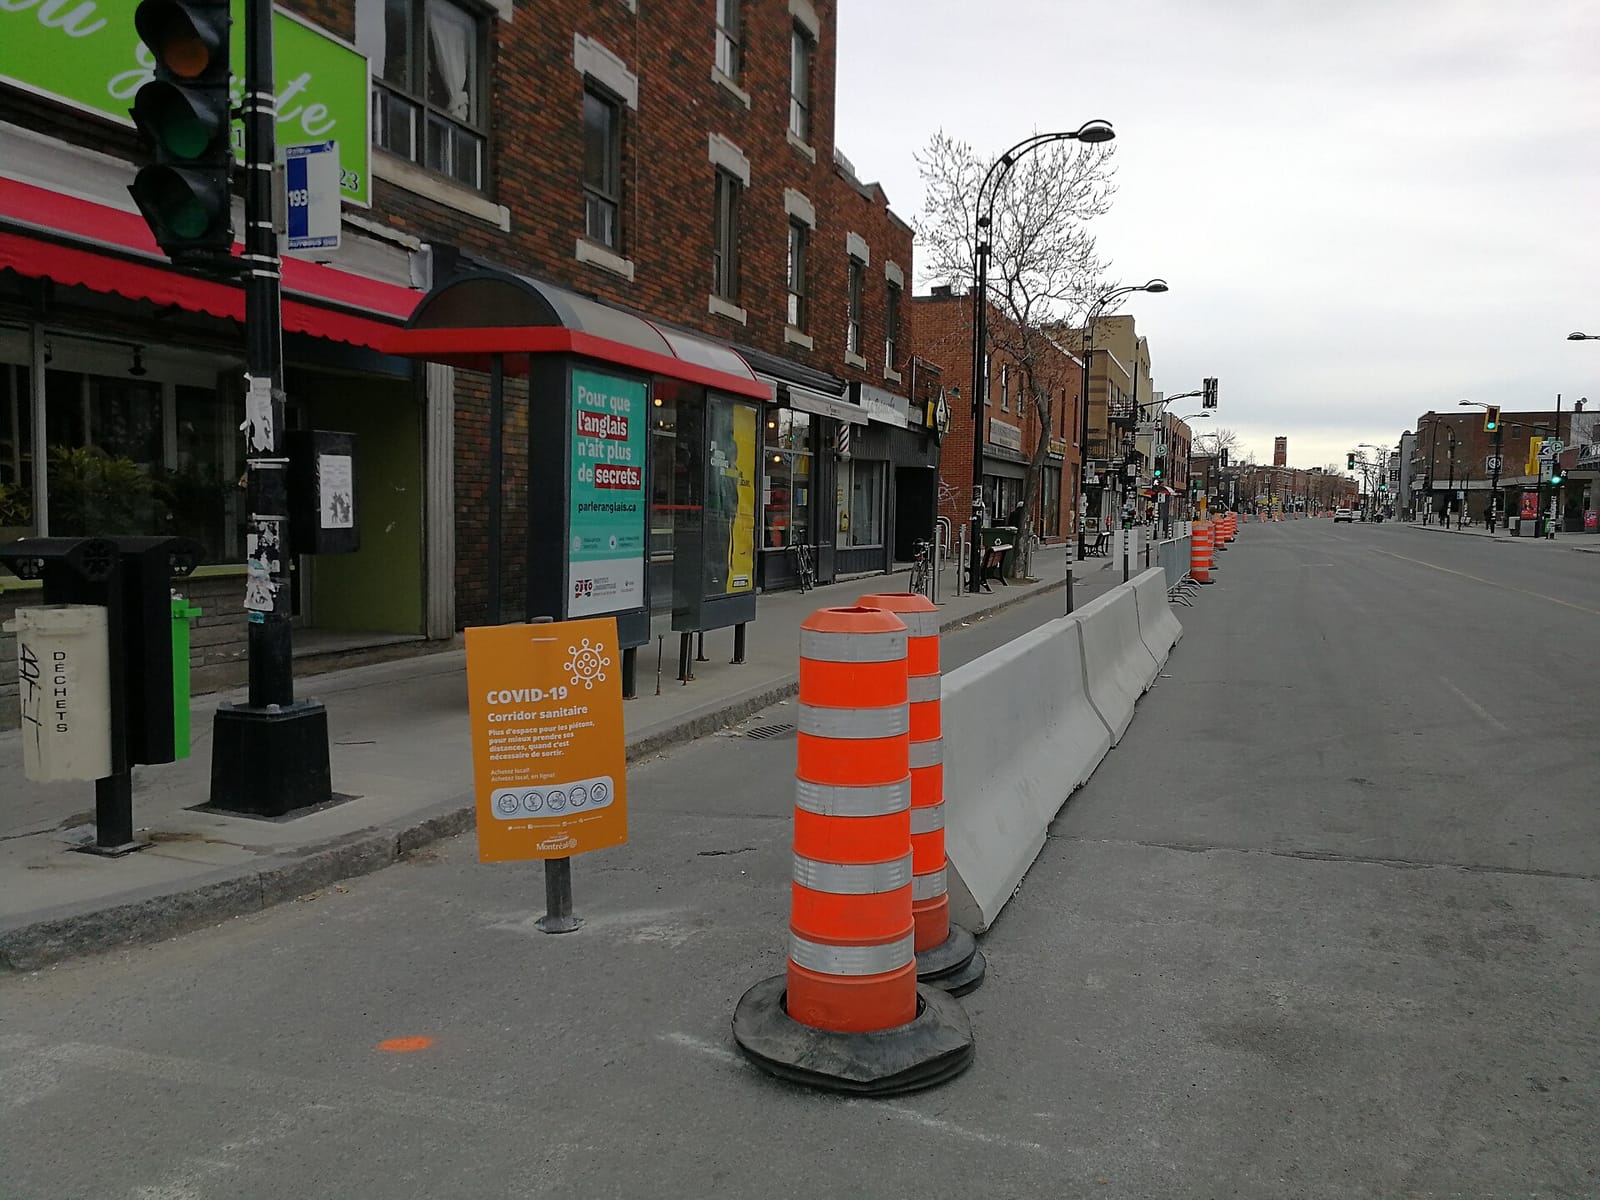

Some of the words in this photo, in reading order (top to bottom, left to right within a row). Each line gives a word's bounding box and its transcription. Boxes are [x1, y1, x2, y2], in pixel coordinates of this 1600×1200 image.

[288, 188, 308, 208] 193
[577, 385, 608, 408] Pour
[609, 395, 632, 416] que
[577, 409, 628, 438] l'anglais
[577, 440, 606, 460] n'ait
[606, 439, 633, 465] plus
[577, 464, 594, 483] de
[595, 466, 642, 486] secrets.
[577, 500, 638, 514] parleranglais.ca
[53, 651, 69, 733] DECHETS
[486, 686, 567, 704] COVID-19
[487, 711, 536, 722] Corridor
[539, 705, 588, 719] sanitaire
[488, 729, 504, 737] Plus
[505, 727, 537, 737] d'espace
[538, 726, 556, 735] pour
[568, 720, 595, 731] piétons,
[488, 738, 506, 746] pour
[507, 736, 531, 744] mieux
[532, 734, 561, 744] prendre
[562, 731, 574, 739] ses
[489, 744, 527, 753] distances,
[528, 741, 551, 751] quand
[552, 740, 569, 748] c'est
[489, 751, 529, 761] nécessaire
[530, 750, 540, 758] de
[541, 748, 564, 758] sortir.
[535, 840, 569, 851] Montréal
